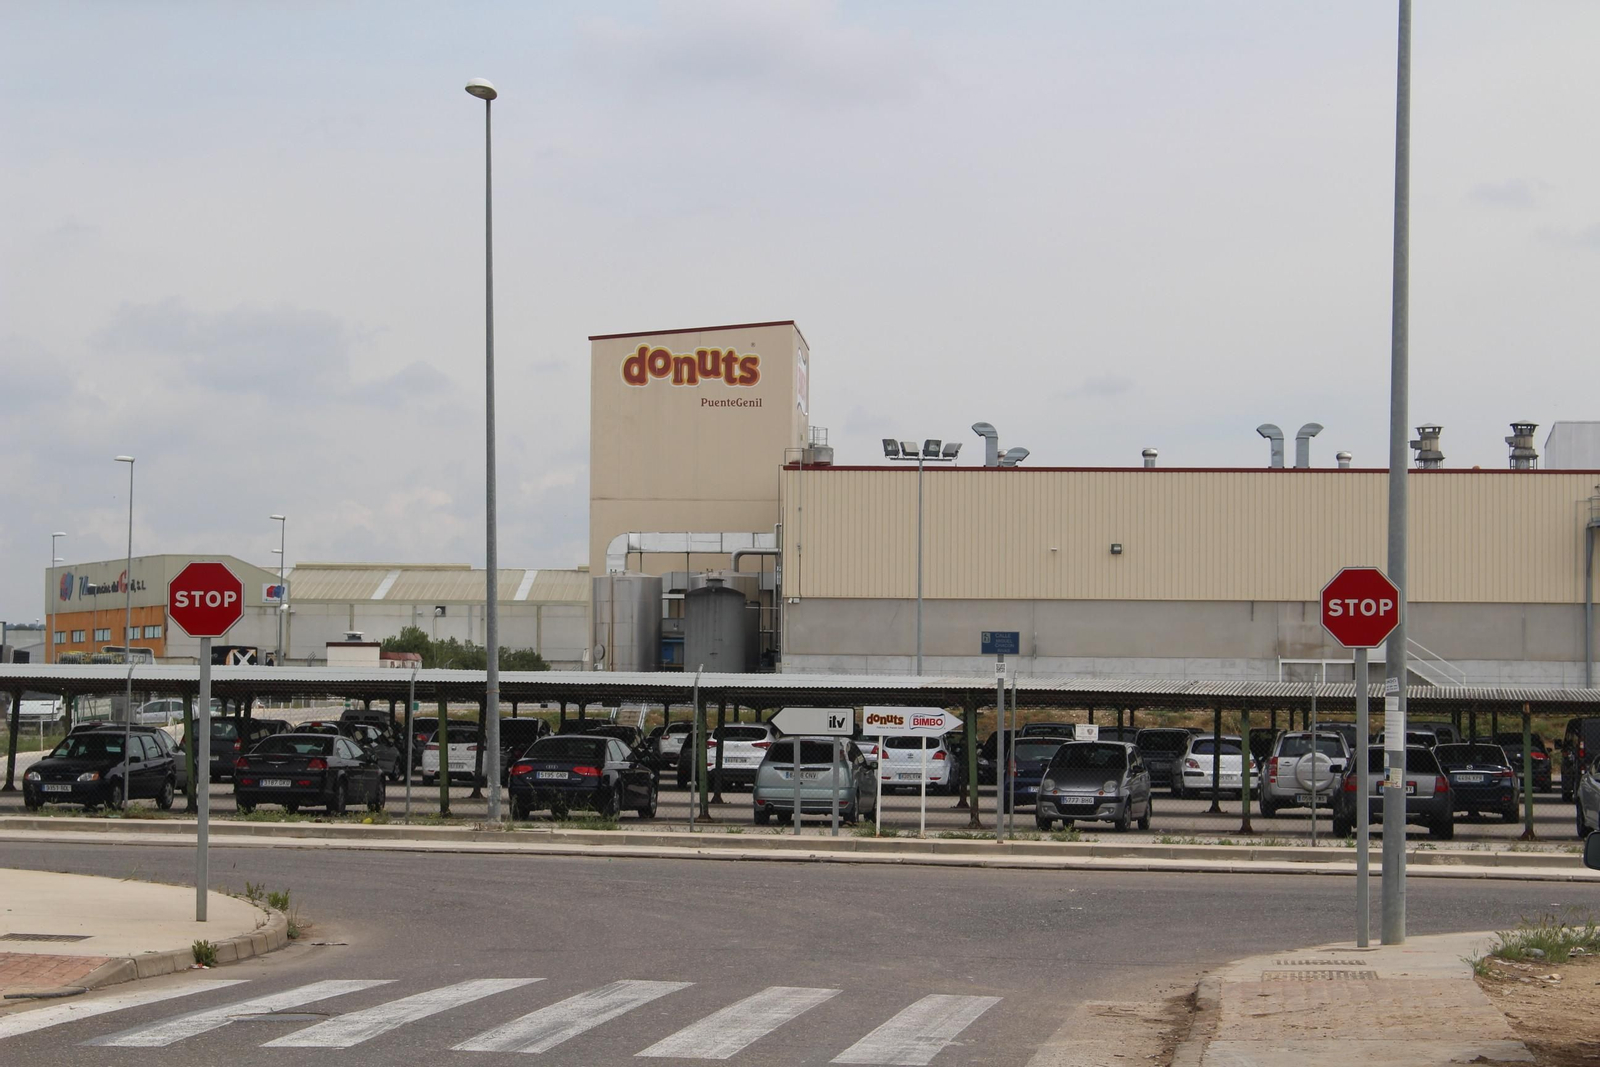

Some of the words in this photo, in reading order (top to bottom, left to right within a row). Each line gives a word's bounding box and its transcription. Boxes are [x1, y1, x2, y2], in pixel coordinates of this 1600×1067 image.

[621, 343, 761, 387] donuts
[701, 398, 762, 408] PuenteGenil
[175, 590, 237, 608] STOP
[1328, 598, 1393, 617] STOP
[866, 713, 904, 725] donuts
[913, 718, 943, 726] BIMBO
